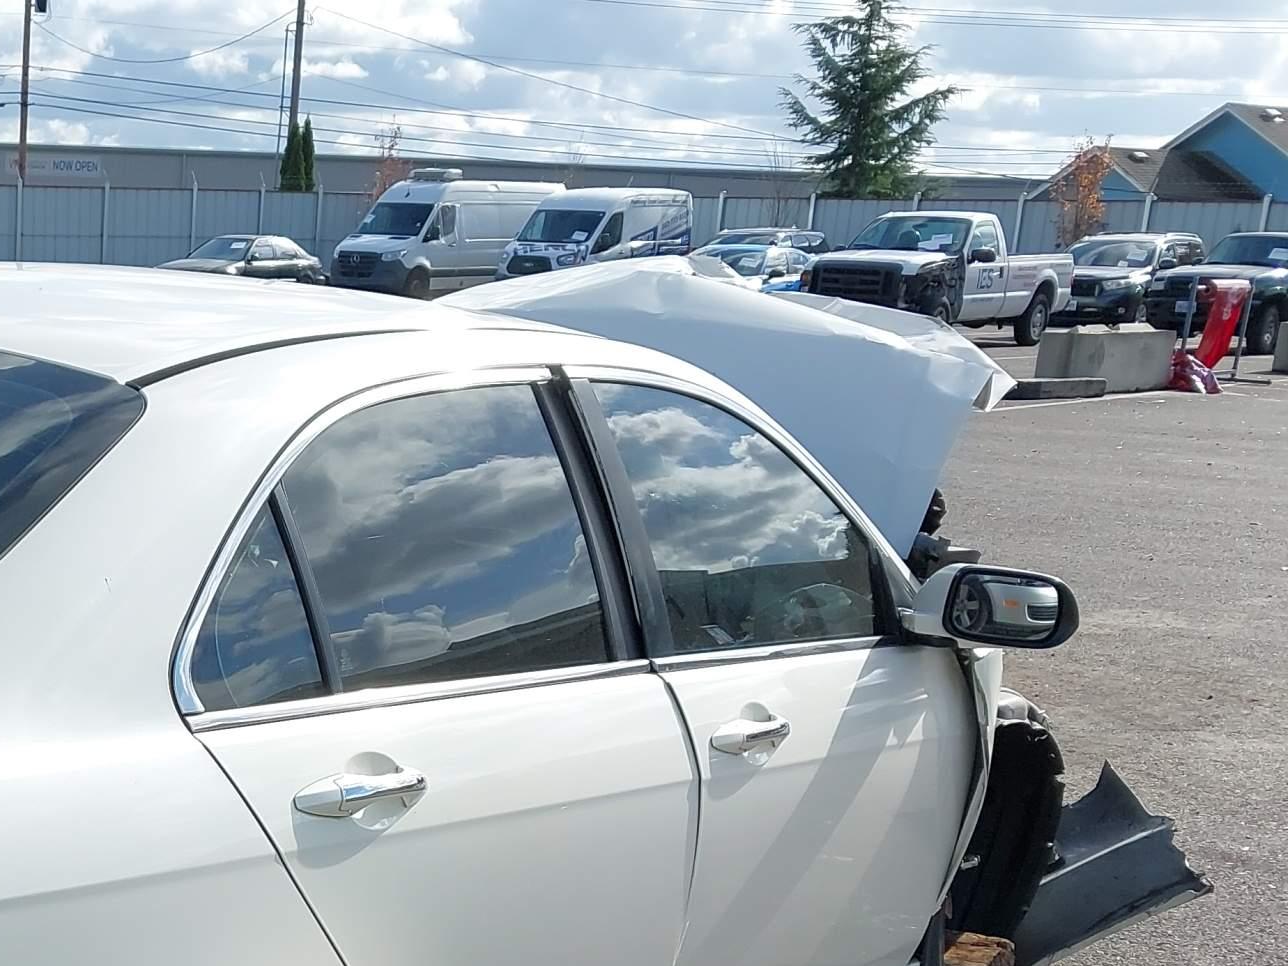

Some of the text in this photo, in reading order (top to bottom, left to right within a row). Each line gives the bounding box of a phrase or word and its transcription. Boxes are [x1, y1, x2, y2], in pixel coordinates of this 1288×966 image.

[52, 160, 73, 171] NOW
[74, 160, 98, 172] OPEN
[976, 268, 994, 289] IES
